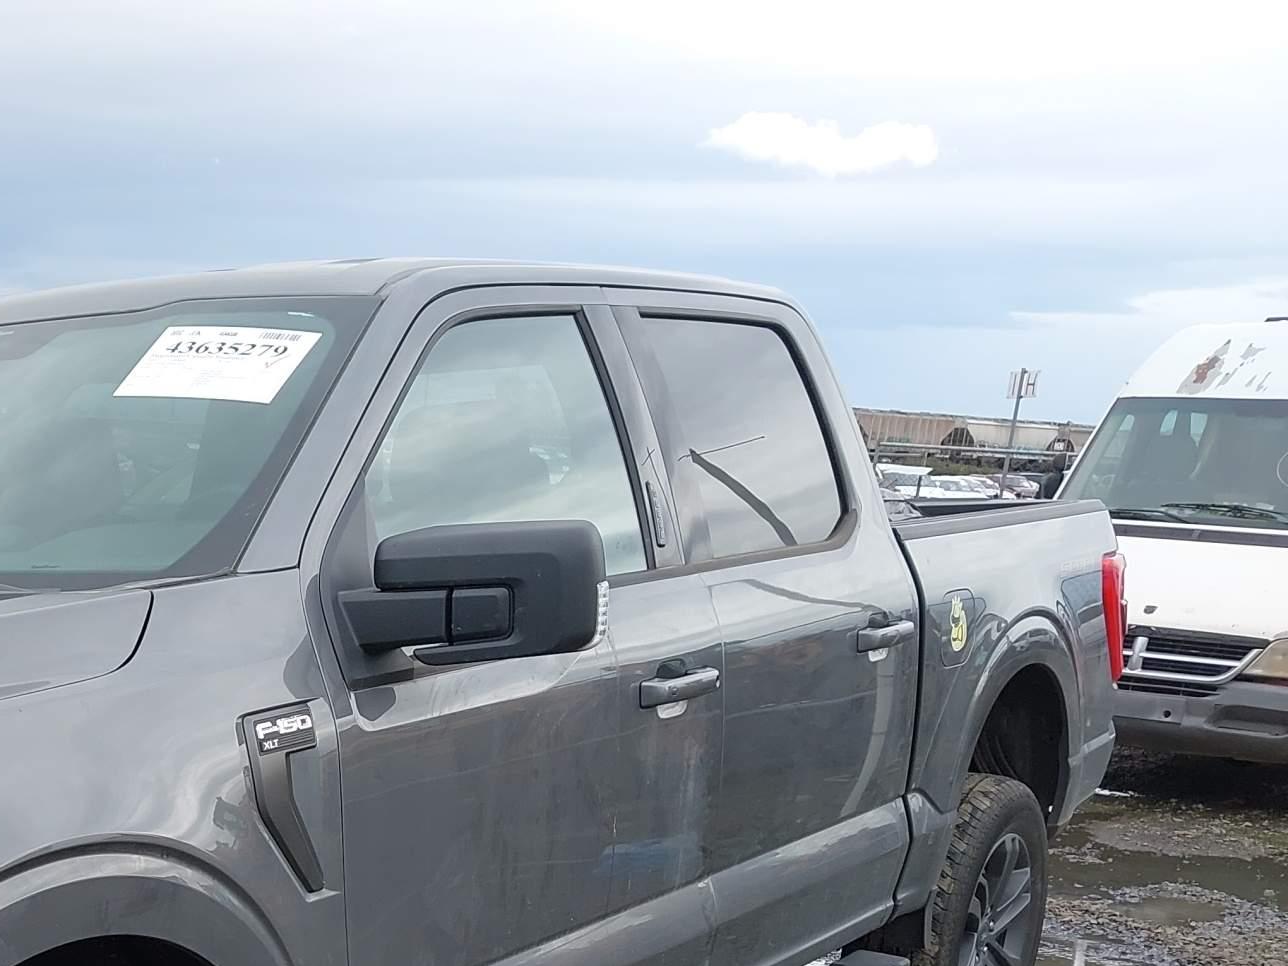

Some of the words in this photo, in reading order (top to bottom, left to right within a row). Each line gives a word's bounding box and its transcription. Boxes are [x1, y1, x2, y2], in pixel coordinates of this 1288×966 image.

[166, 340, 288, 357] 43635279
[256, 715, 312, 740] F-150
[263, 738, 279, 751] XLT
